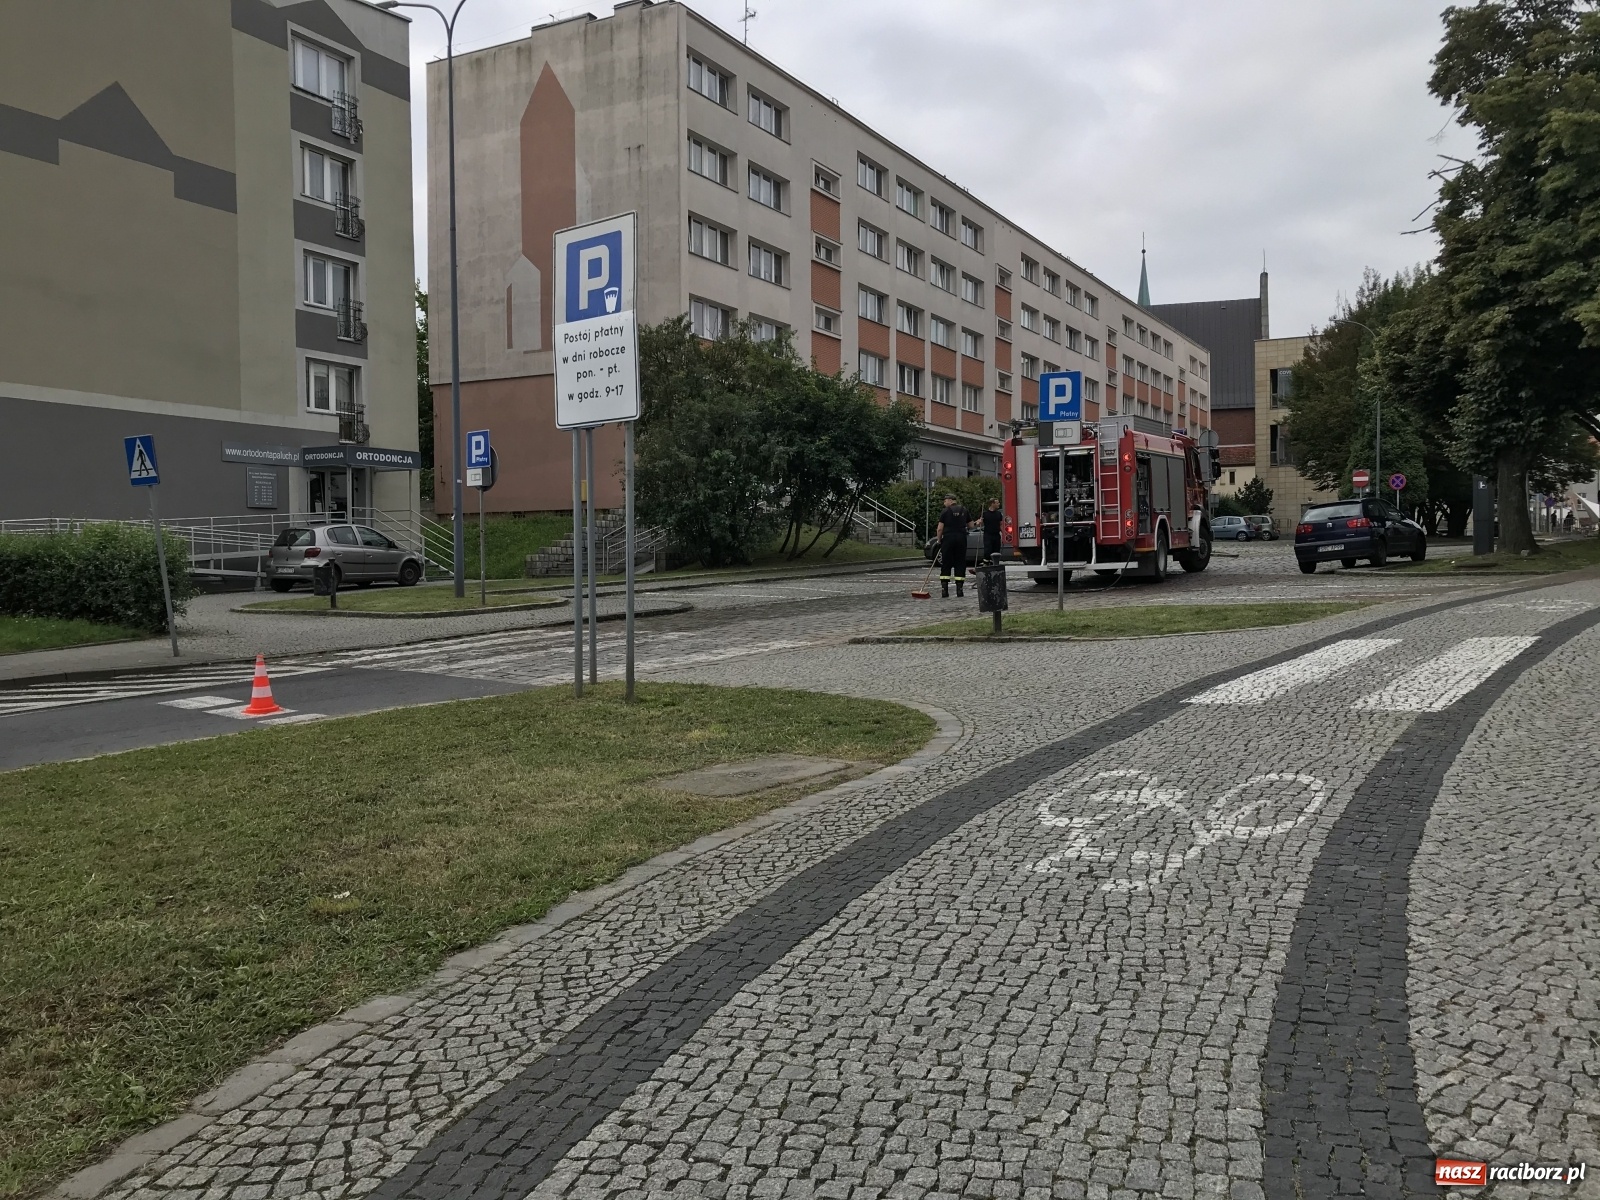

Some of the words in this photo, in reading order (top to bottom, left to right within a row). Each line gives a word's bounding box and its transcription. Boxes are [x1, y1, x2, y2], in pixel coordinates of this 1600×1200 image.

[578, 244, 610, 311] P
[564, 328, 591, 344] Postój
[594, 325, 624, 341] płatny
[562, 356, 569, 364] w
[572, 350, 586, 362] dni
[589, 346, 626, 359] robocze
[576, 369, 596, 382] pon.
[607, 363, 621, 377] pt.
[568, 392, 574, 401] w
[577, 388, 602, 403] godz.
[605, 385, 624, 397] 9-17
[1048, 377, 1073, 415] P
[225, 448, 300, 462] www.ortodontapaluch.pl
[304, 452, 344, 460] ORTODONCJA
[356, 452, 413, 464] ORTODONCJA
[471, 435, 485, 464] P
